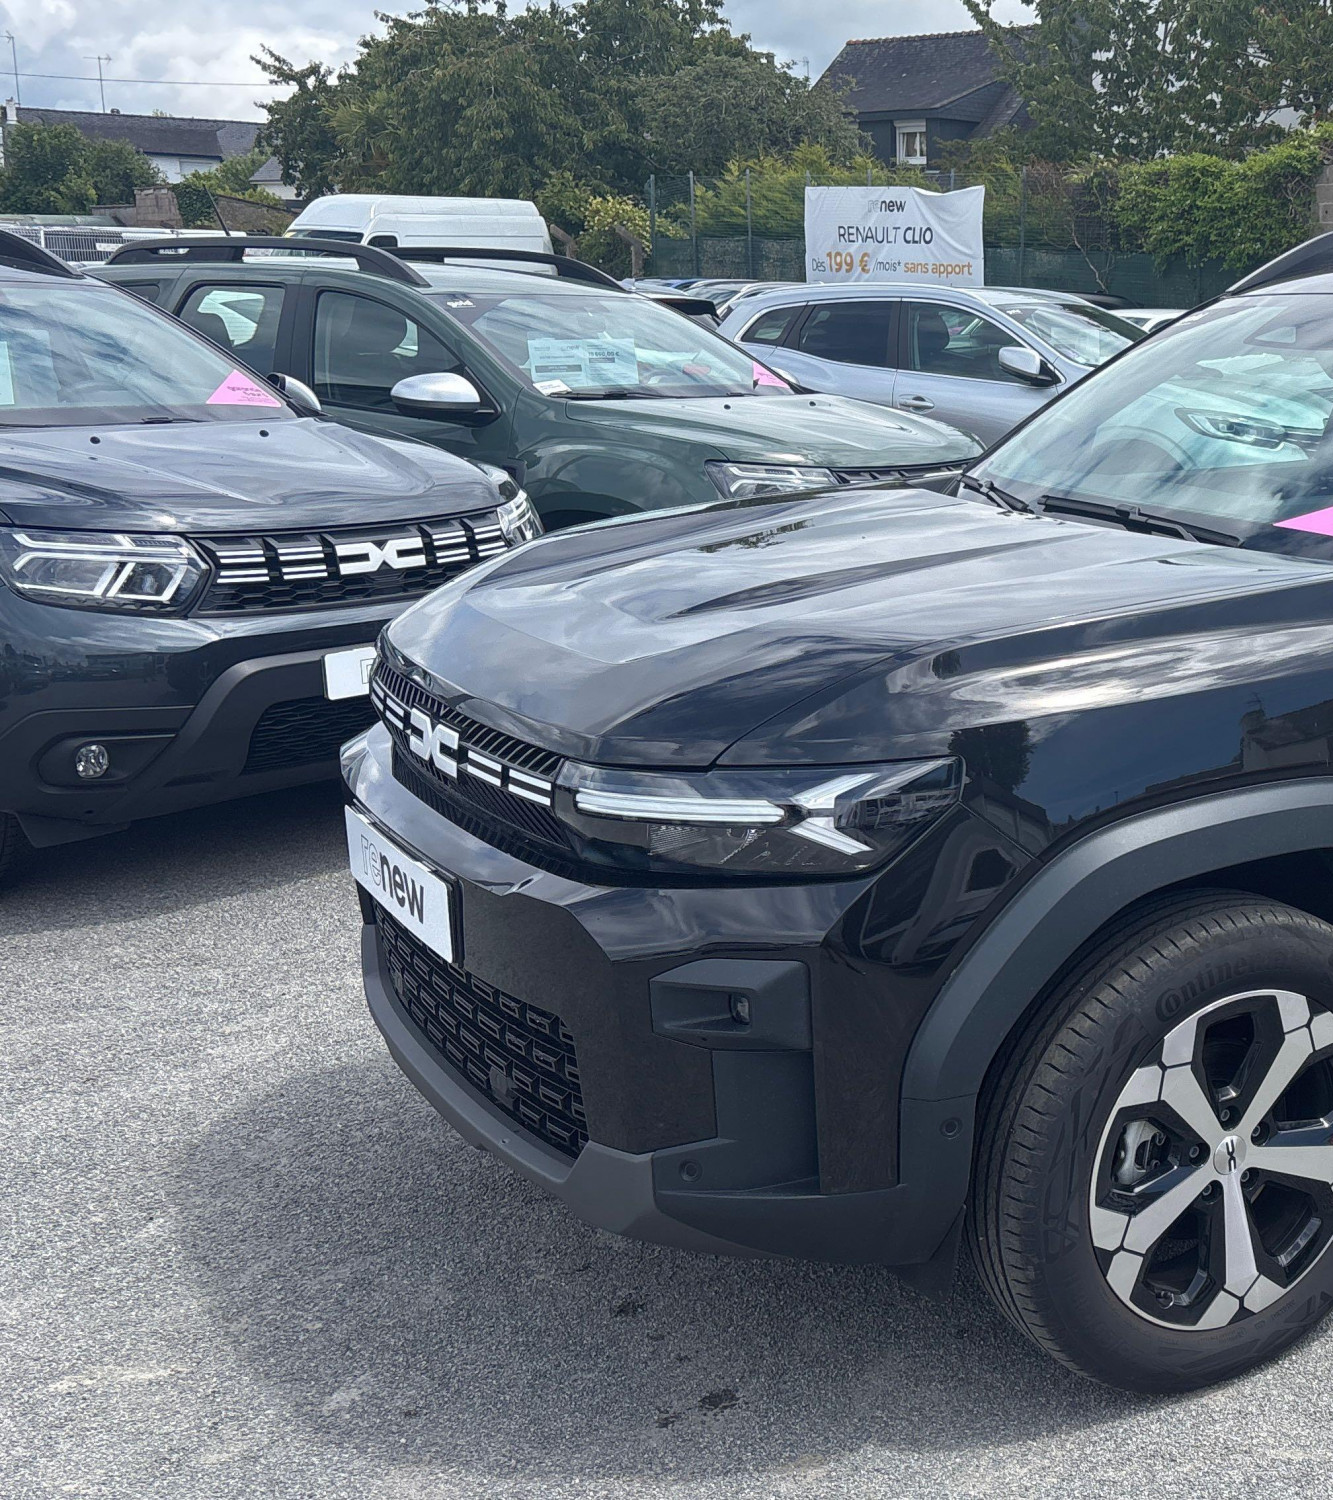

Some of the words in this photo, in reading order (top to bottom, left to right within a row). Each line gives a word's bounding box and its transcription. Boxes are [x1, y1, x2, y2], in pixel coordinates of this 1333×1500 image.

[868, 200, 906, 213] renew
[837, 225, 901, 244] RENAULT
[903, 226, 934, 245] CLIO
[811, 257, 826, 272] Dès
[826, 251, 854, 273] 199
[859, 252, 870, 274] €
[903, 262, 929, 274] sans
[931, 261, 973, 278] apport
[361, 834, 425, 925] renew
